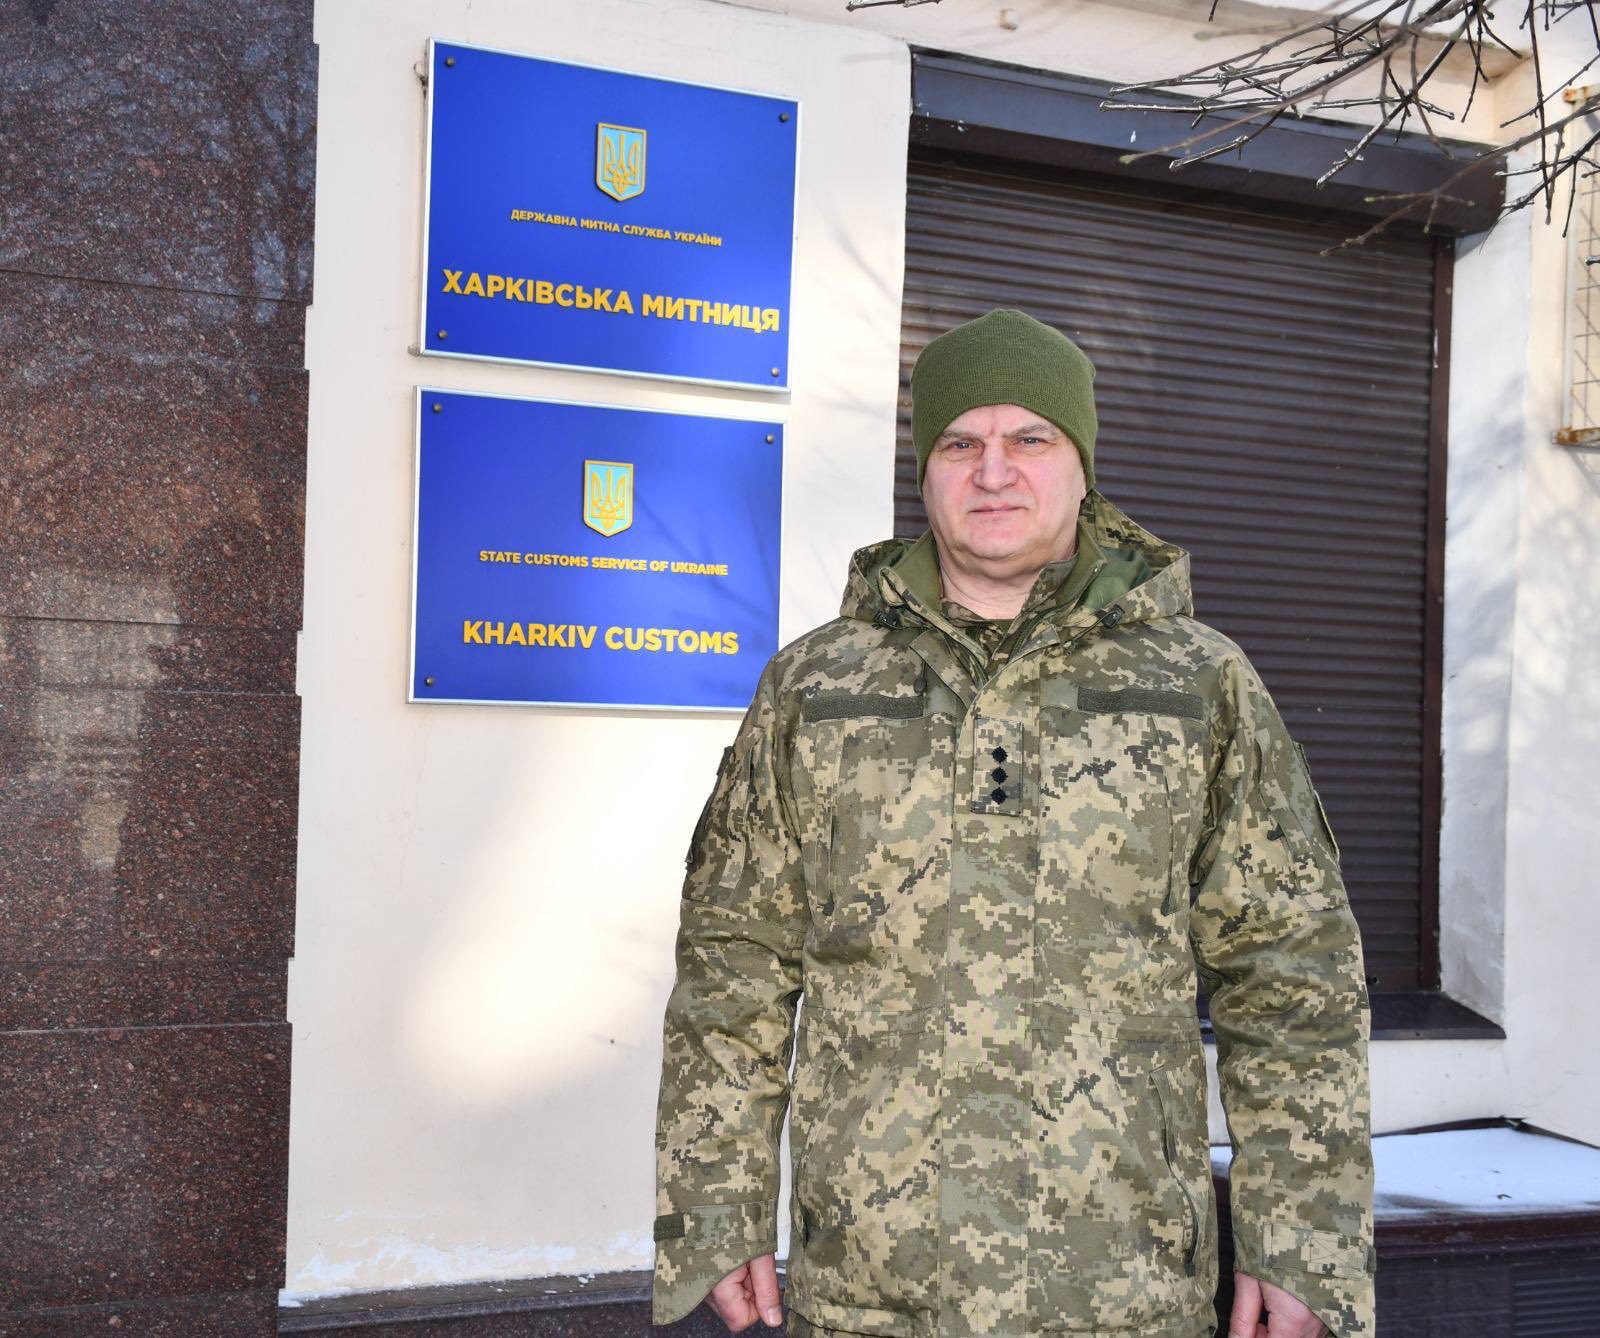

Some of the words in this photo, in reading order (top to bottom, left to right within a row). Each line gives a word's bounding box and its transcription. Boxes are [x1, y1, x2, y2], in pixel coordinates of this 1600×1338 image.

[511, 209, 577, 227] ДЕРЖАВНА
[580, 219, 620, 233] МИТНА
[623, 224, 671, 240] СЛУЖБА
[674, 231, 721, 246] УКРАЇНИ
[442, 269, 634, 315] ХАРКІВСЬКА
[641, 293, 780, 334] МИТНИЦЯ
[479, 550, 521, 564] STATE
[524, 553, 588, 567] CUSTOMS
[591, 556, 646, 571] SERVICE
[649, 560, 669, 573] OF
[671, 561, 728, 576] UKRAINE
[463, 620, 597, 649] KHARKIV
[605, 627, 739, 655] CUSTOMS
